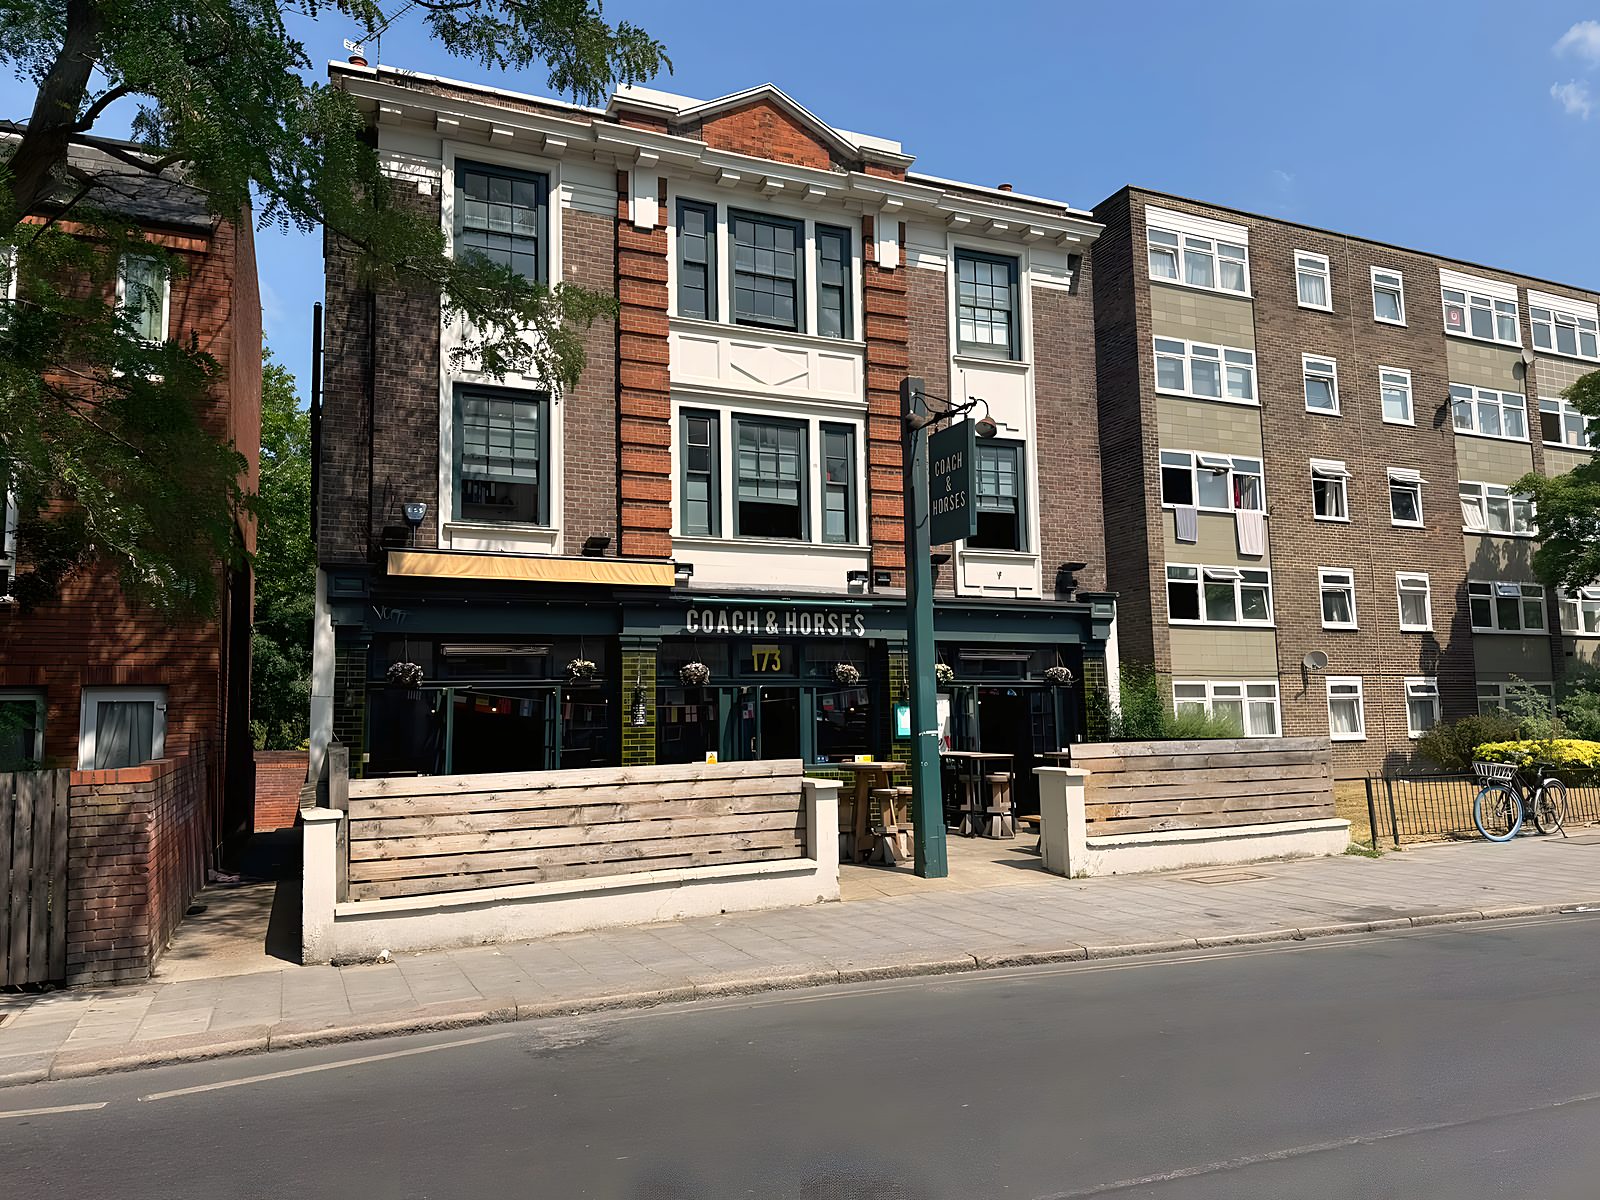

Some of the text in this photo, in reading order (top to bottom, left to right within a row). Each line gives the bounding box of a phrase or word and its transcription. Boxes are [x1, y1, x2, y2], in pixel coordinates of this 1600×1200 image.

[934, 451, 962, 477] COACH
[945, 475, 952, 492] &
[932, 490, 966, 516] HORSES
[686, 609, 866, 637] COACH & HORSES
[751, 650, 781, 672] 173
